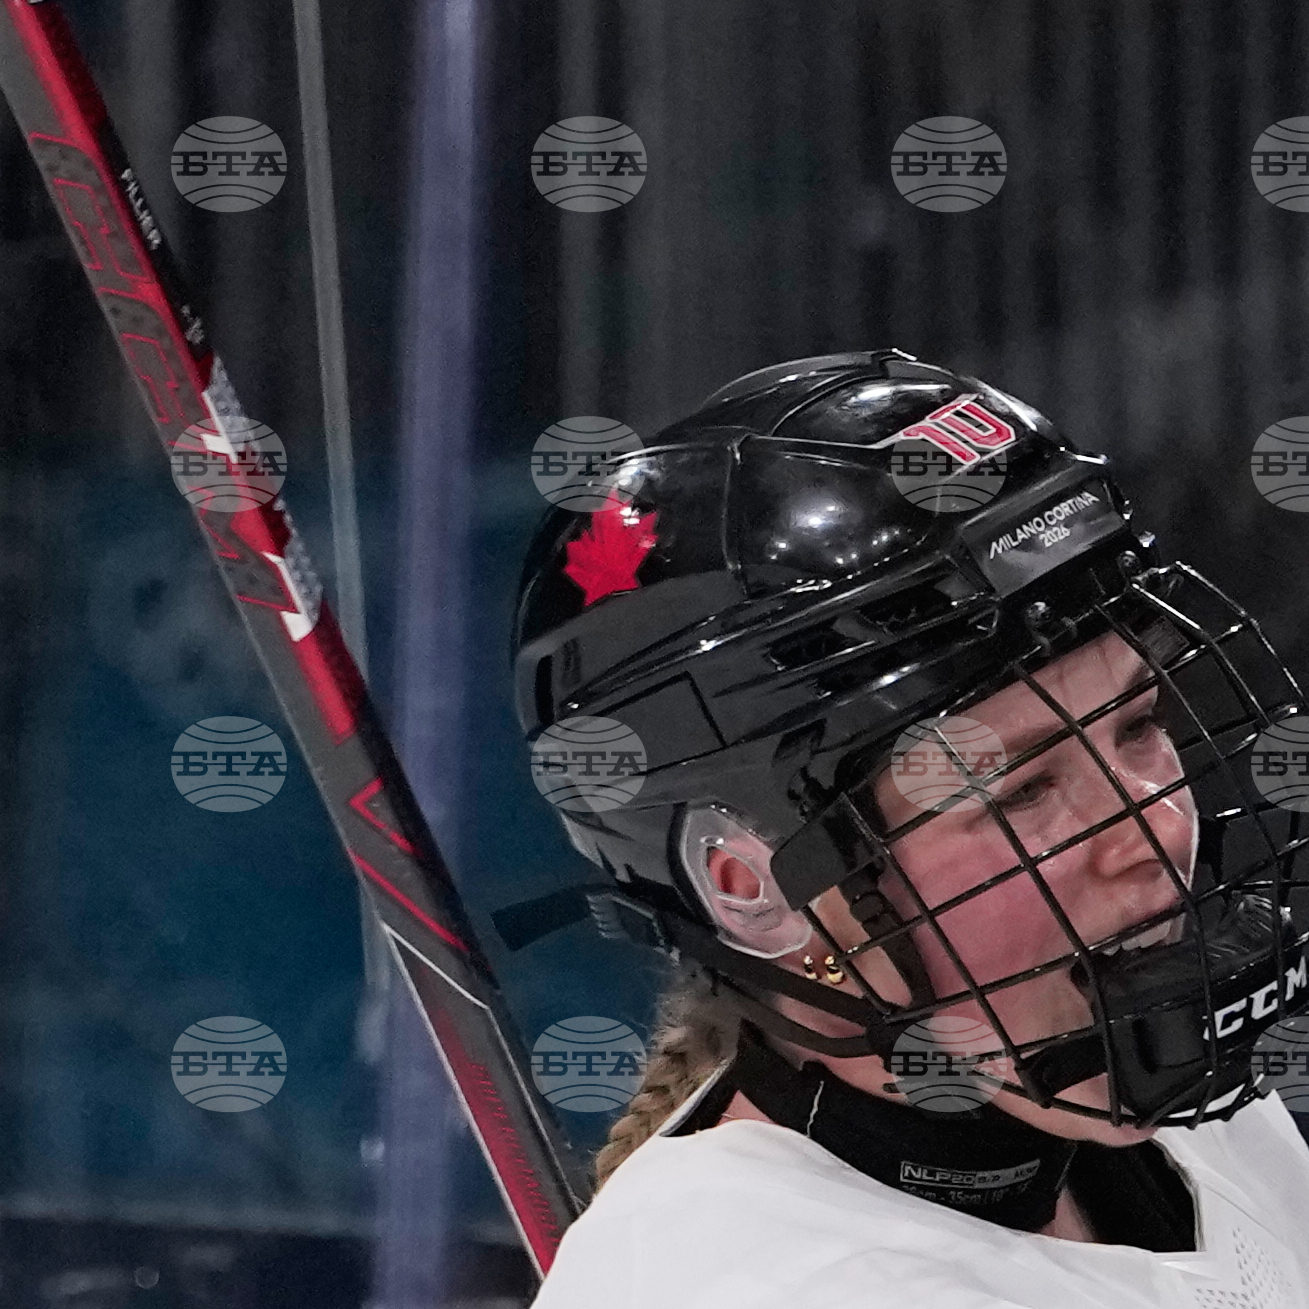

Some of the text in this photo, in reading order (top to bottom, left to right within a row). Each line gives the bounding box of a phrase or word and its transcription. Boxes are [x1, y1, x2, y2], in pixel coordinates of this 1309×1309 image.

[901, 400, 1016, 465] 10
[990, 491, 1100, 560] MILANO CORTINA
[1039, 524, 1071, 548] 2026
[1202, 955, 1308, 1041] CCM
